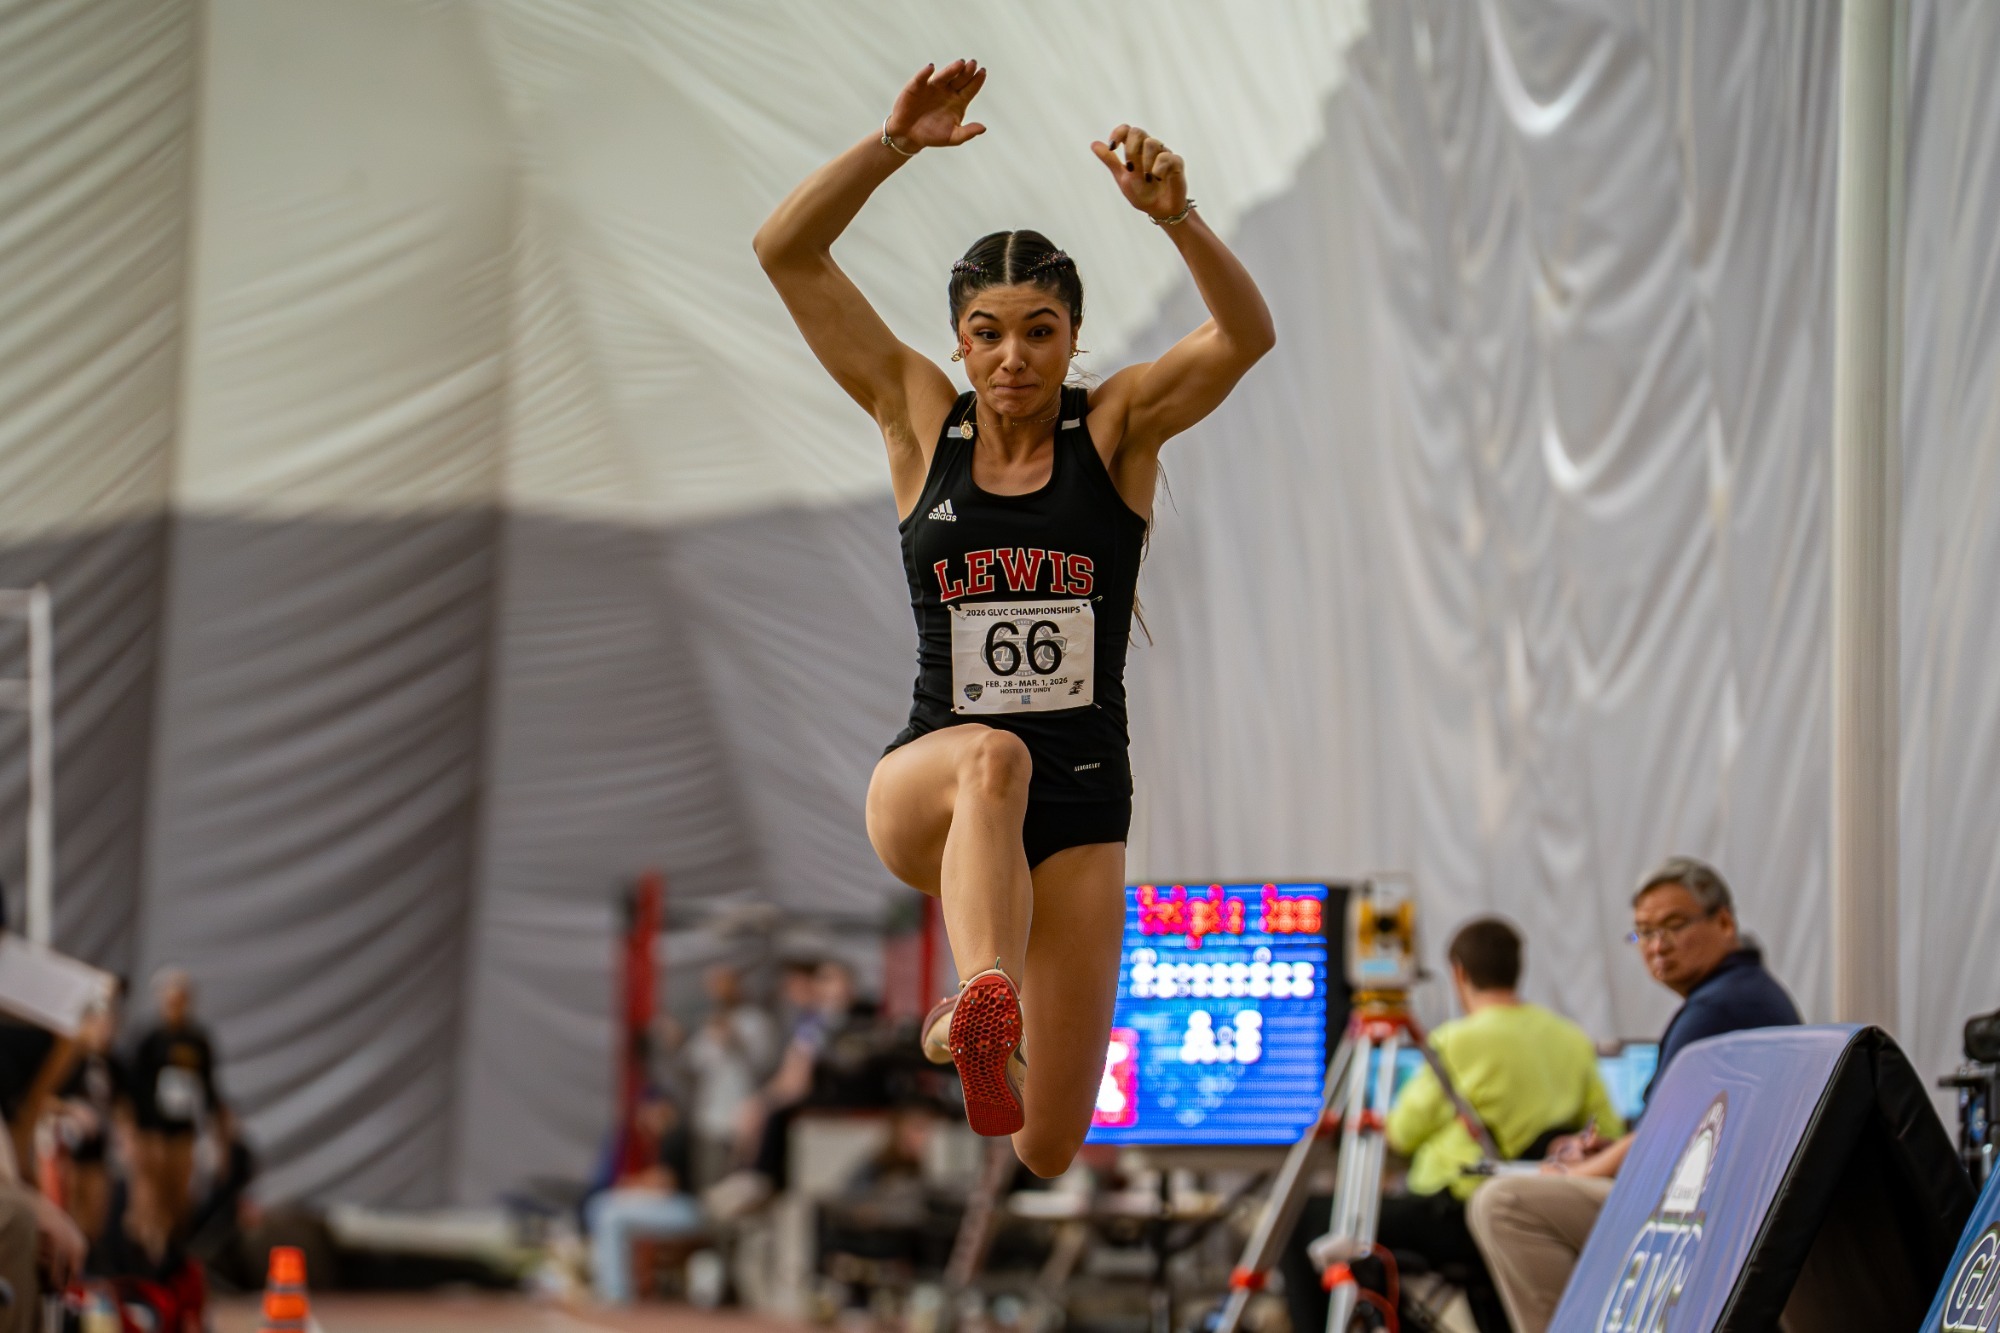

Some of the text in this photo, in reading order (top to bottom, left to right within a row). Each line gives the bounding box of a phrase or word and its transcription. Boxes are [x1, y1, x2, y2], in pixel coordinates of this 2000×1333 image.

[928, 511, 957, 523] adidas
[933, 547, 1094, 603] LEWIS
[966, 605, 1081, 617] 2026 GLVC CHAMPIONSHIPS
[985, 620, 1061, 676] 66
[985, 680, 1001, 688] FEB.
[1018, 679, 1039, 687] MAR.
[1041, 679, 1048, 687] 1,
[1049, 677, 1068, 686] 2026
